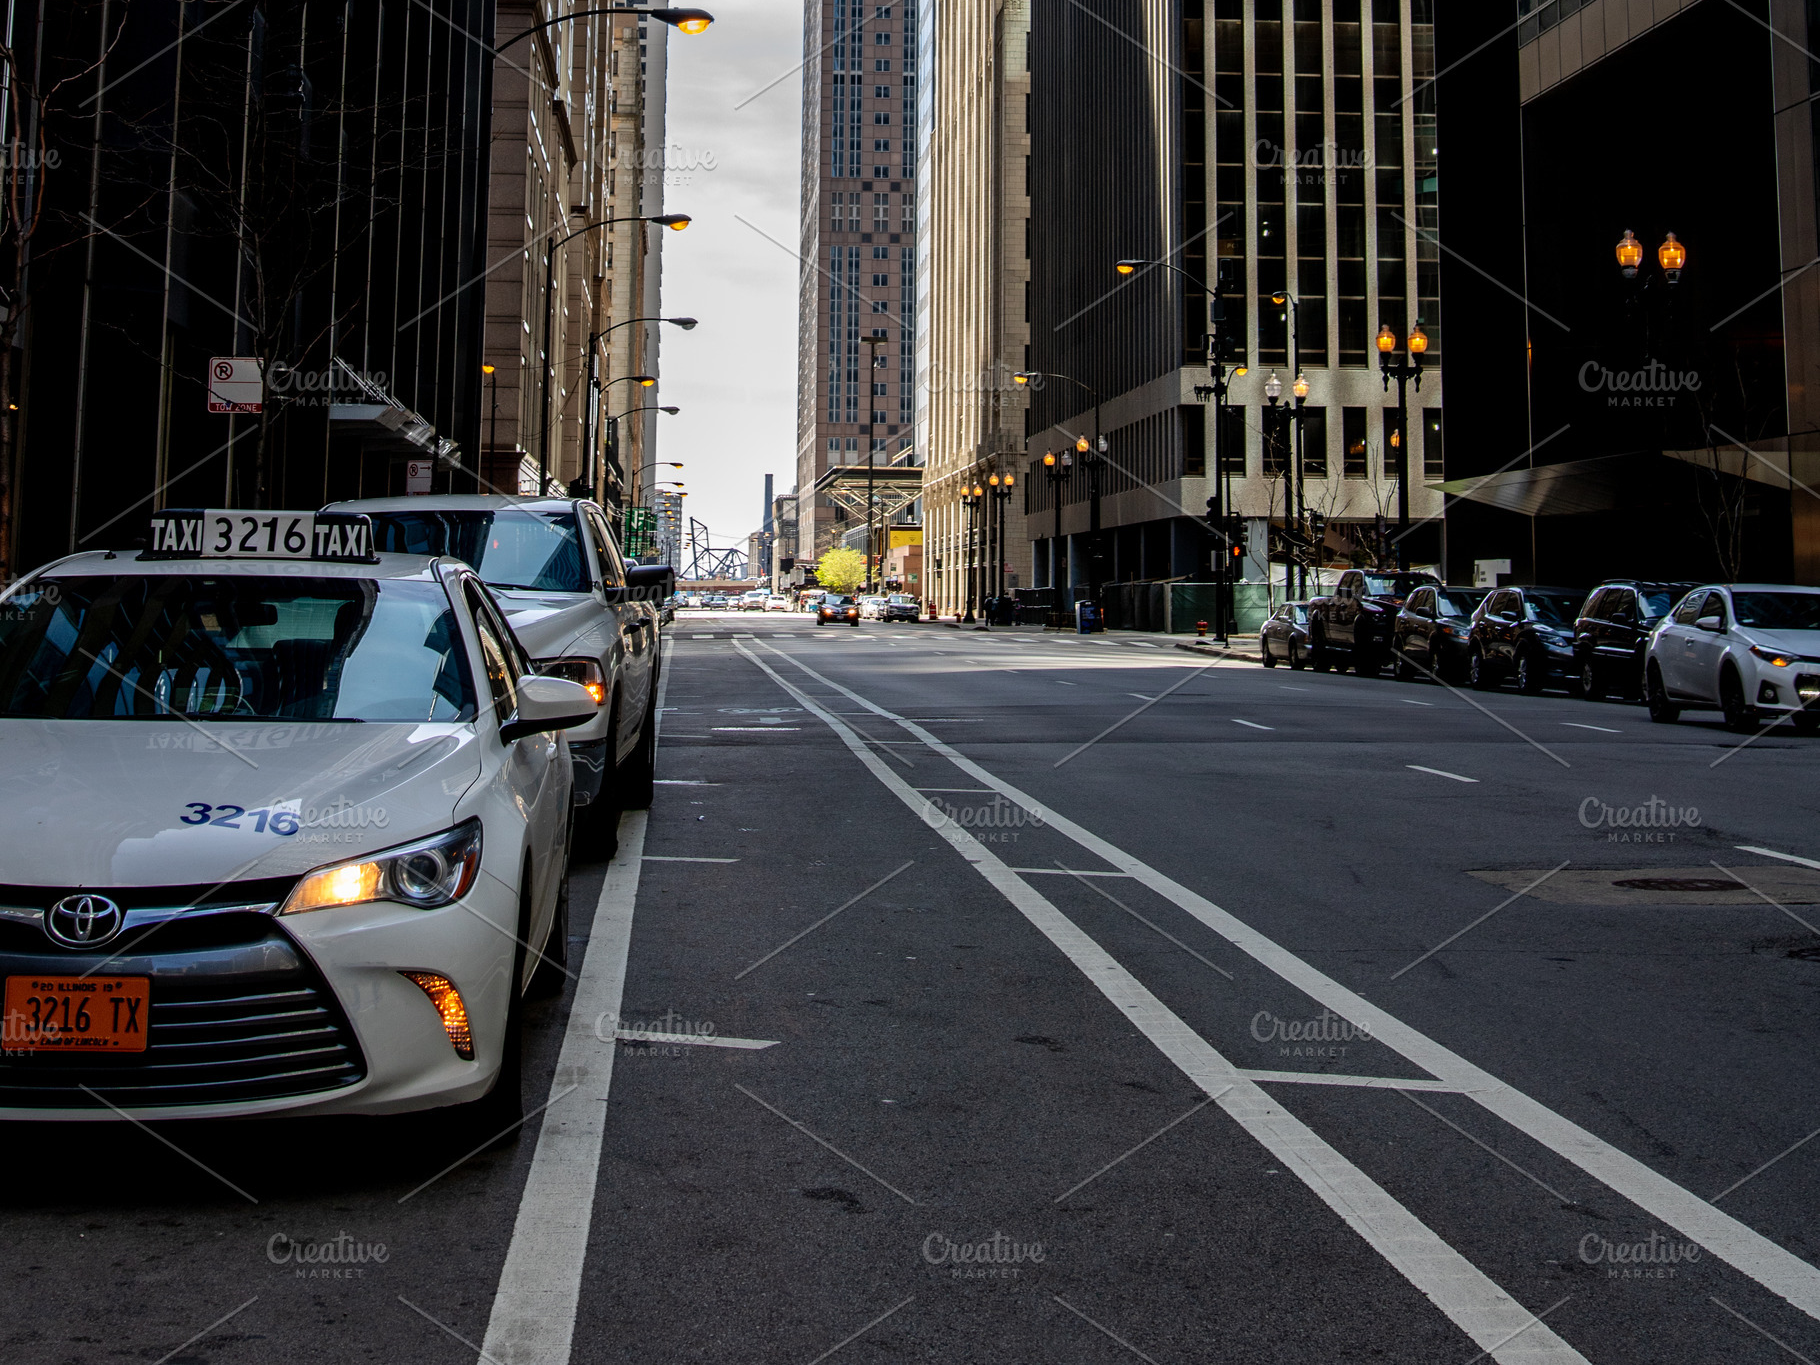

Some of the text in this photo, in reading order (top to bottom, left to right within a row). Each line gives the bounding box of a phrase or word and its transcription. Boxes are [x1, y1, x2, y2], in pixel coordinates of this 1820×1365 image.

[151, 517, 367, 557] TAXI 3216 TAXI
[180, 803, 300, 836] 3216
[58, 983, 97, 992] ILLINOIS
[103, 983, 113, 992] 19
[25, 996, 141, 1033] 3216 TX
